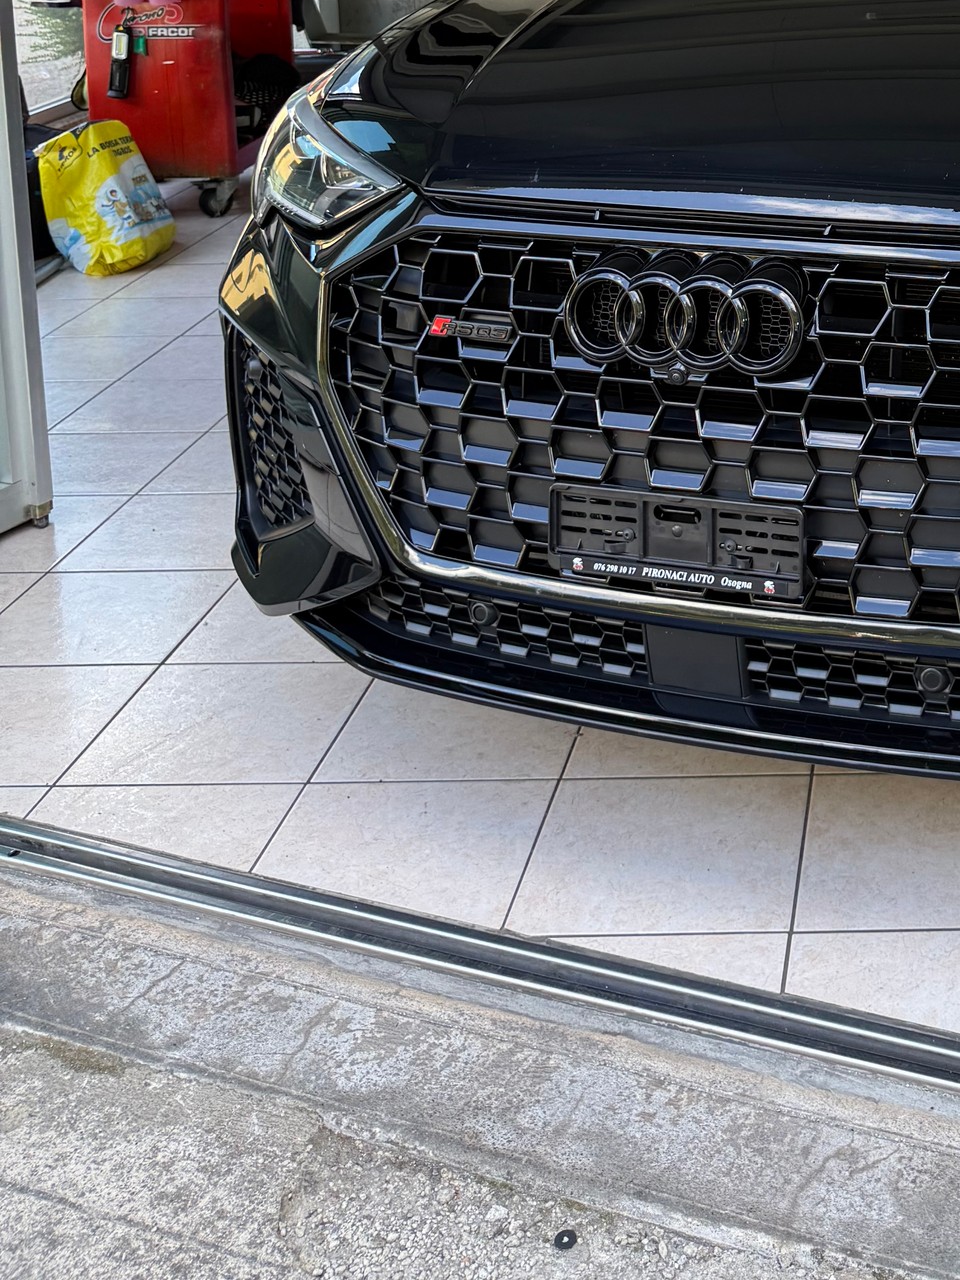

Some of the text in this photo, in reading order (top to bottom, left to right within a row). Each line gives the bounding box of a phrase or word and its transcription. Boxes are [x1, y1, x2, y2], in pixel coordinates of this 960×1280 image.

[593, 562, 753, 590] 076 298 10 17 PIRONACI AUTO Osogna
